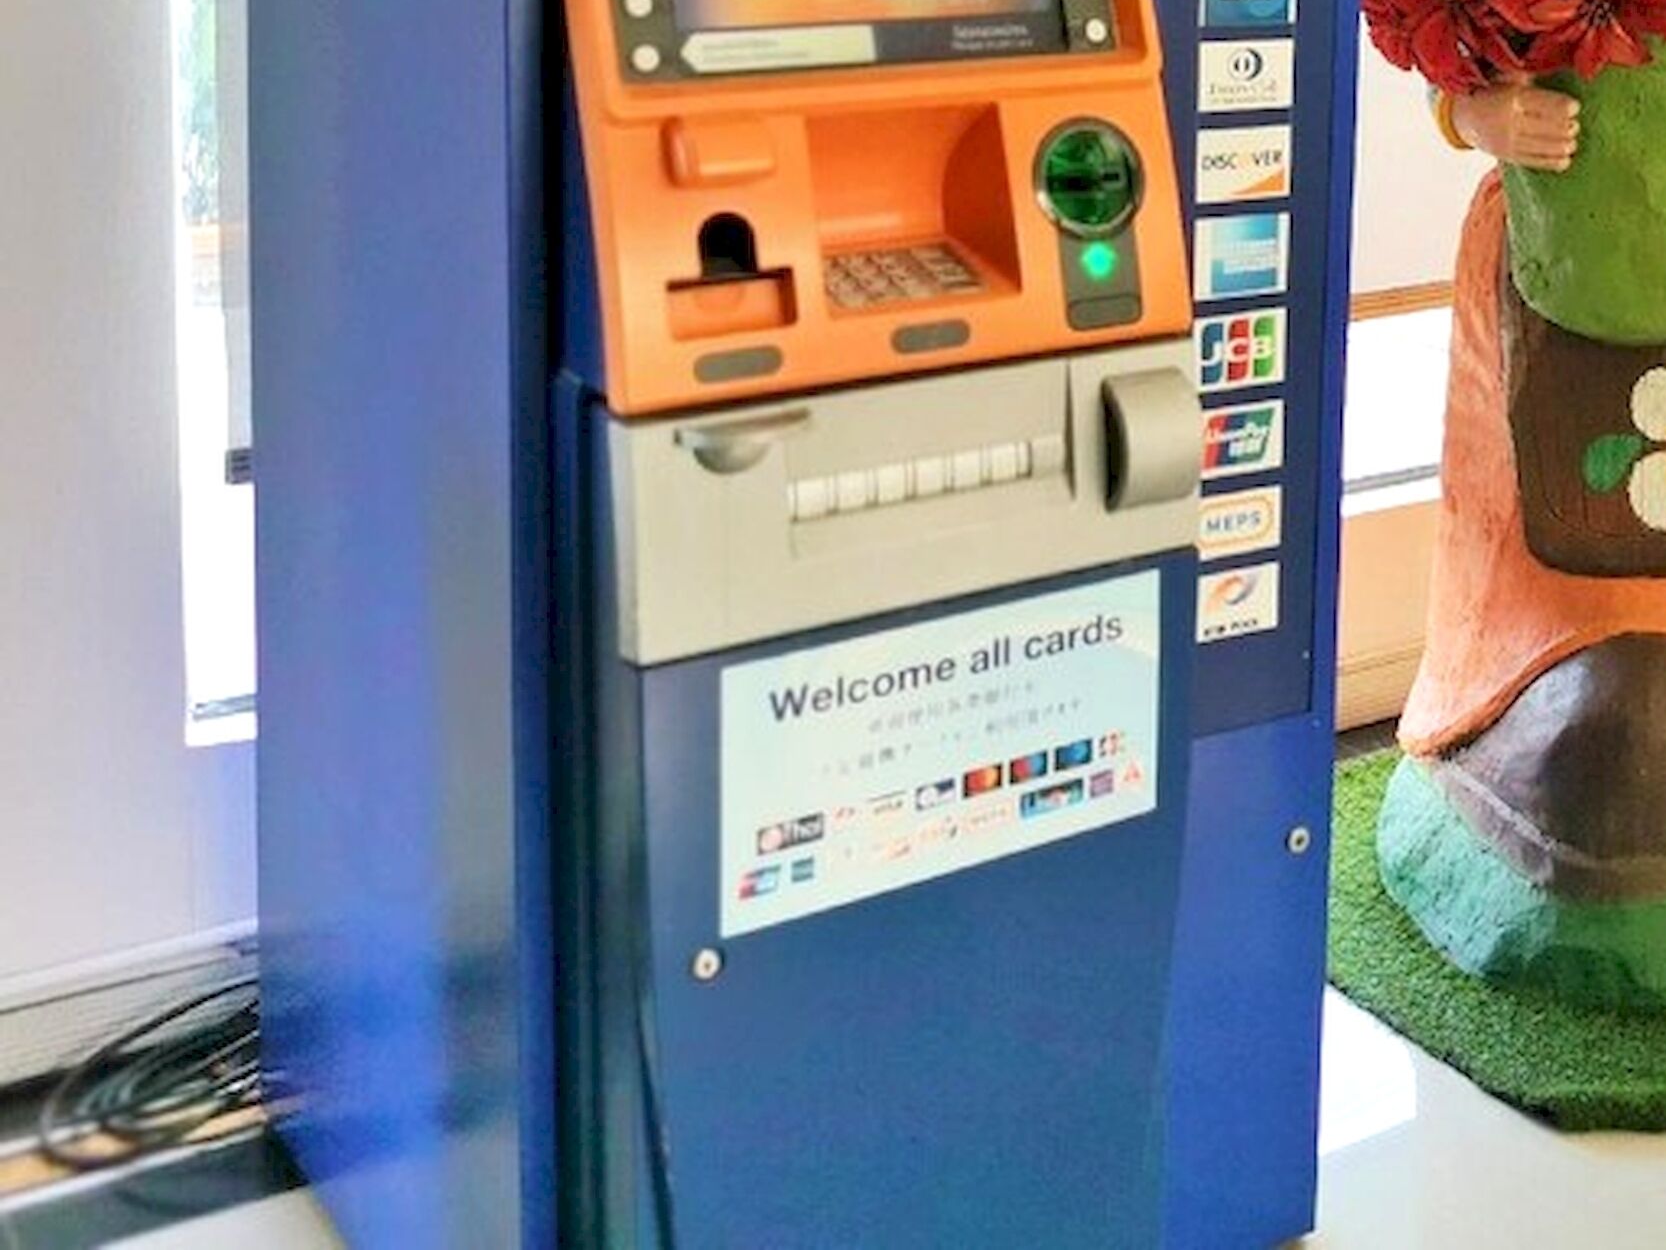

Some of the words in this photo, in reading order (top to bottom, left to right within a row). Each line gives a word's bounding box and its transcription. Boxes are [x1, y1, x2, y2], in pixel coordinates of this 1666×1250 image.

[1201, 335, 1273, 367] JCB
[1206, 509, 1262, 531] MEPS
[768, 654, 957, 722] Welcome
[968, 637, 1012, 673] all
[1023, 614, 1124, 661] cards
